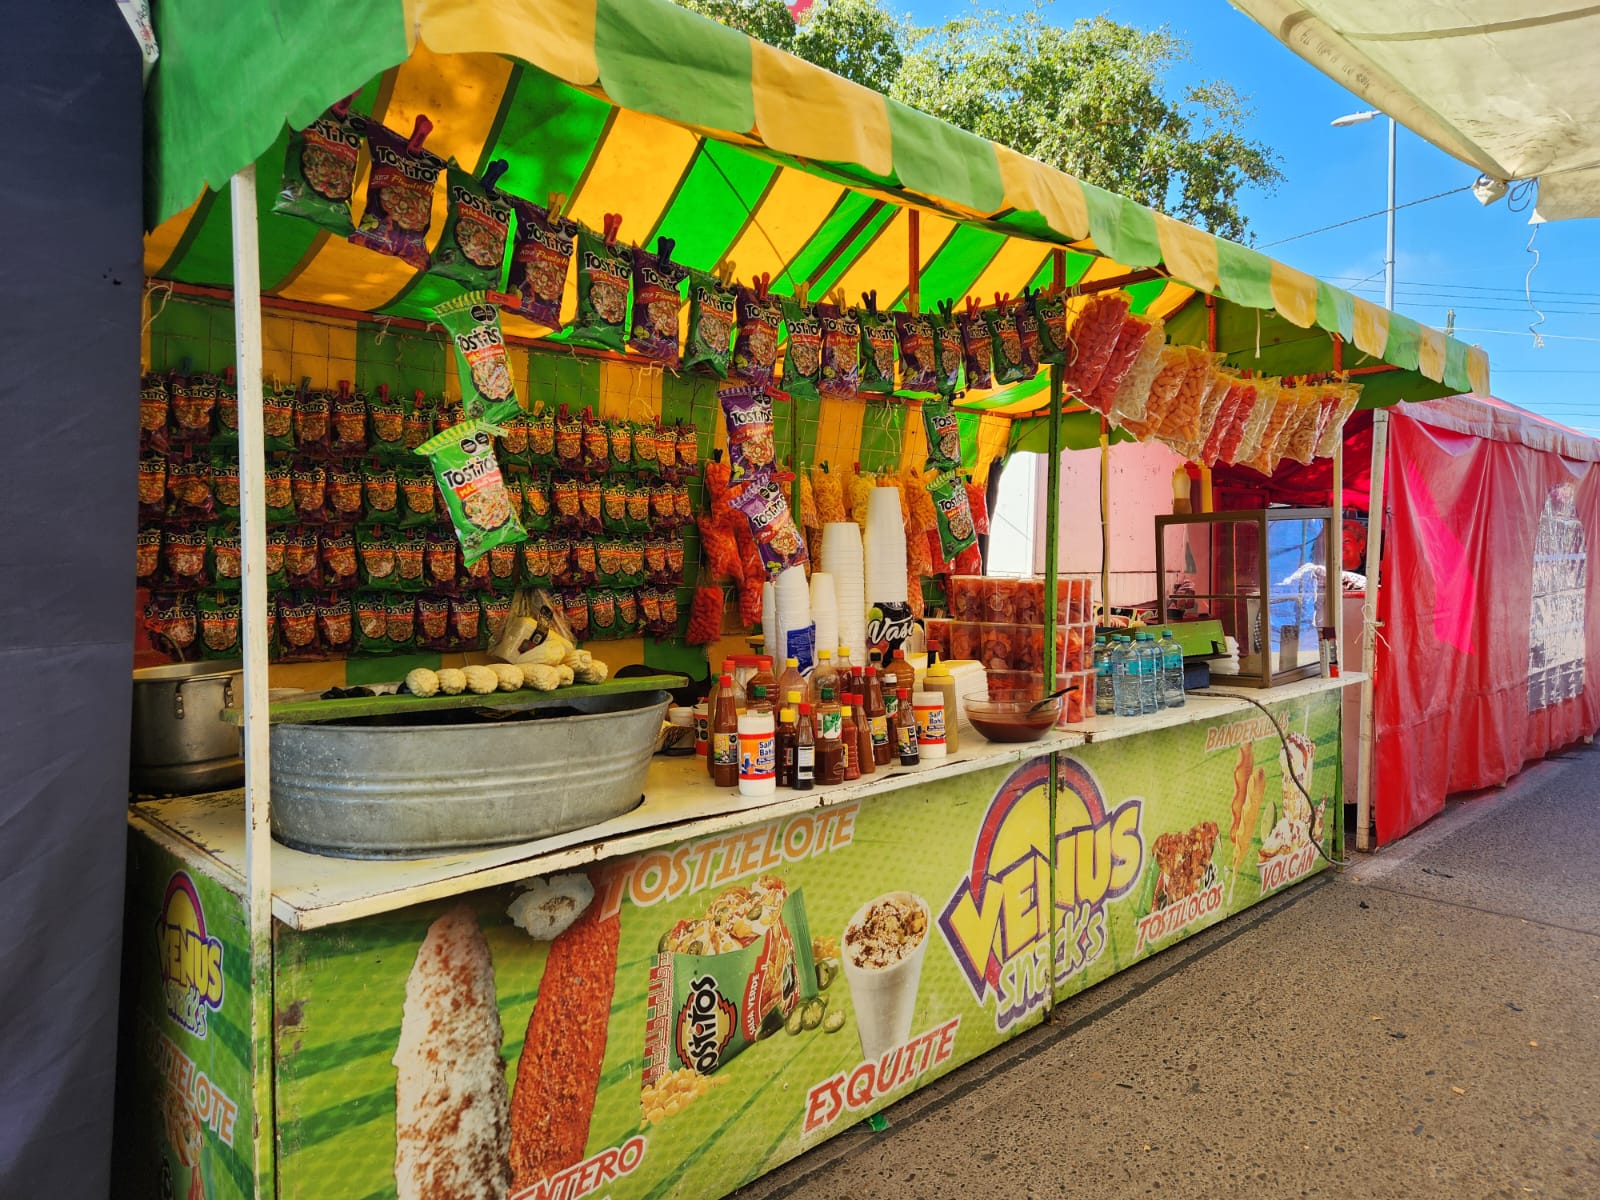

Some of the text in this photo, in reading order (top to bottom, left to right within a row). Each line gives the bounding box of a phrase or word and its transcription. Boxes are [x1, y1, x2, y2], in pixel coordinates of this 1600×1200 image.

[601, 805, 858, 922] TOSTIELOTE
[940, 799, 1143, 1003] VENUS
[1136, 882, 1225, 956] TOSTILOCOS
[156, 915, 224, 1011] VENUS
[806, 1018, 960, 1133] ESQUITE
